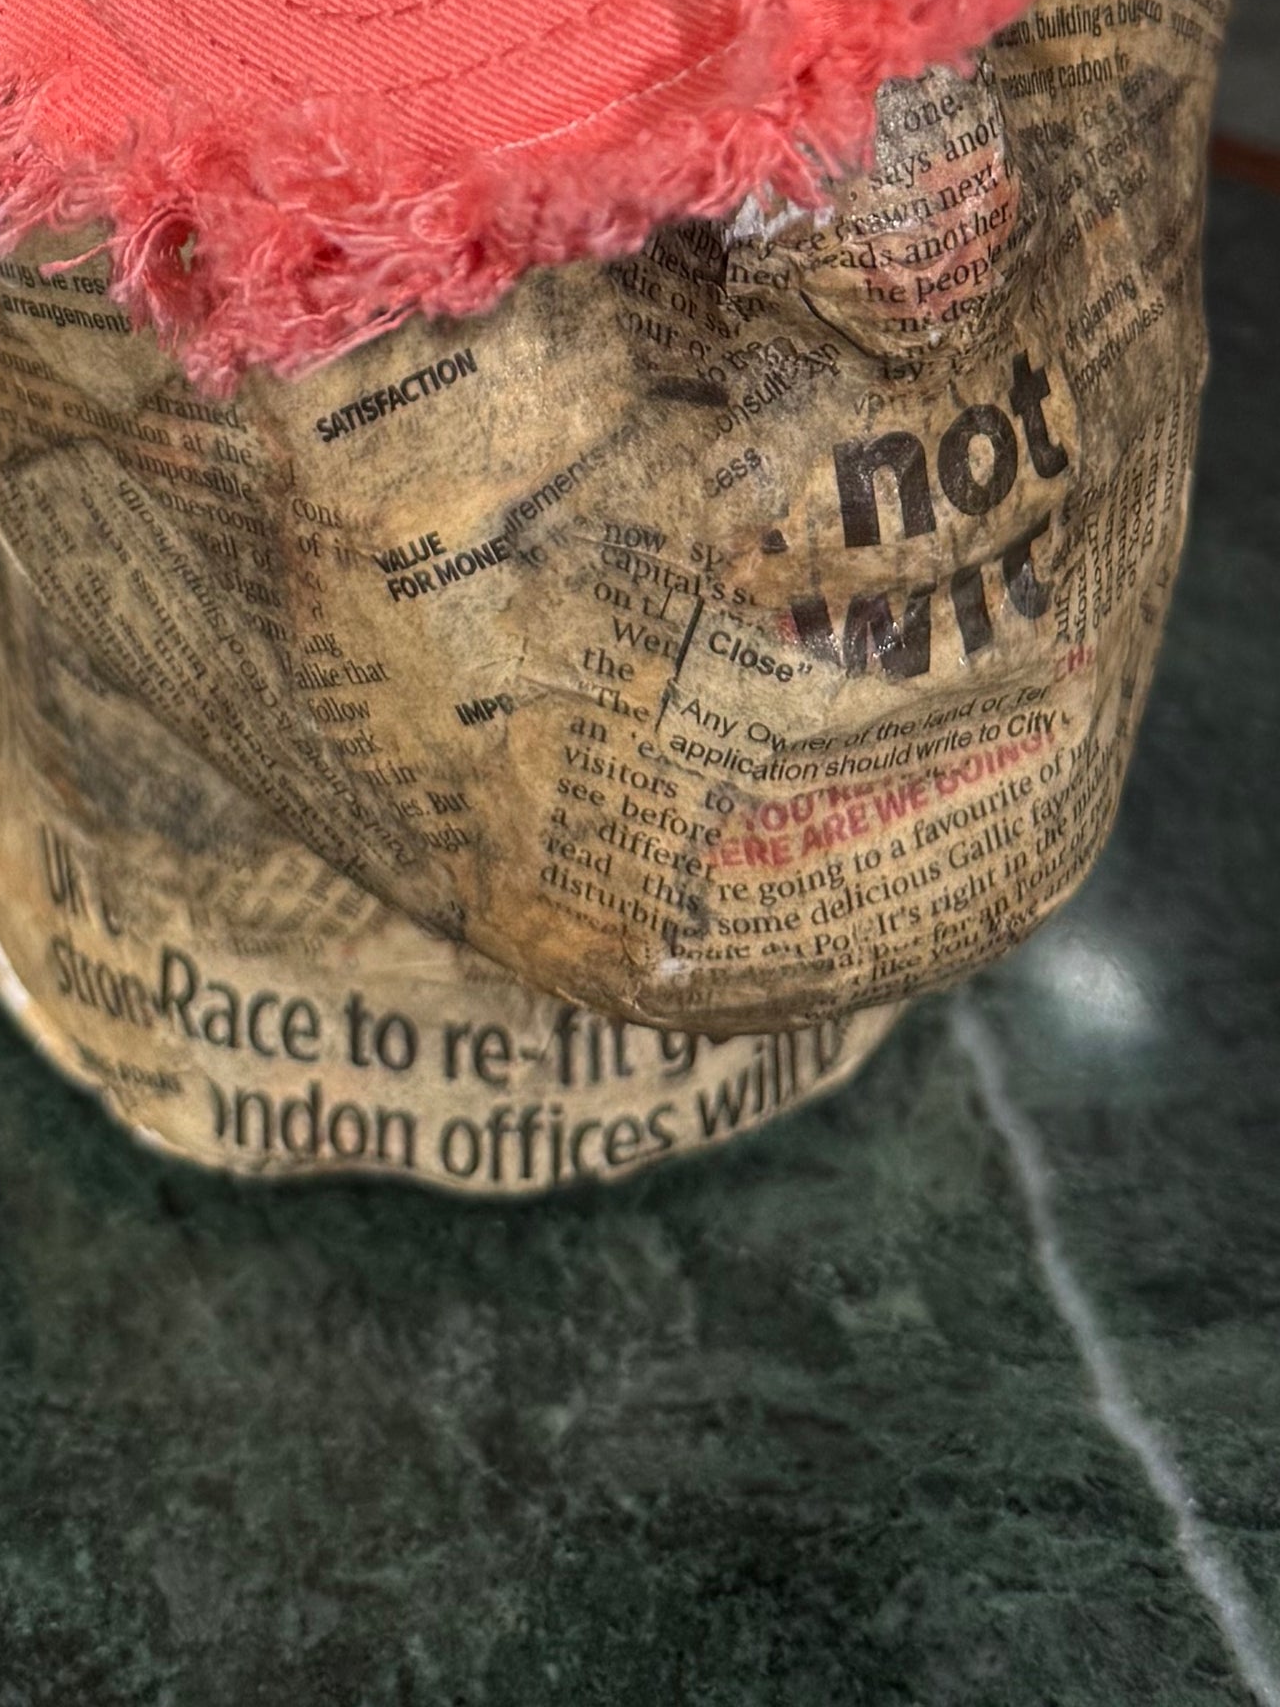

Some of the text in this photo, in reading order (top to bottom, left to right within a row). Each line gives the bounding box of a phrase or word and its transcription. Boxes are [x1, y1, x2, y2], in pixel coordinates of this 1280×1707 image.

[1033, 4, 1102, 40] building
[1057, 54, 1114, 88] carbon
[902, 93, 964, 134] one.
[937, 164, 999, 210] next
[904, 201, 1014, 265] another.
[314, 347, 479, 444] SATISFACTION
[832, 349, 1070, 549] not
[374, 531, 448, 575] VALUE
[604, 518, 670, 554] now
[386, 571, 439, 603] FOR
[593, 580, 632, 611] on
[344, 658, 391, 687] that
[582, 645, 635, 683] the
[569, 715, 609, 743] an
[669, 710, 1056, 785] application should write to City
[680, 697, 739, 739] Any
[747, 719, 837, 754] Owner
[875, 716, 917, 742] the
[921, 697, 977, 731] land
[980, 692, 1013, 715] or
[564, 745, 736, 814] visitors to
[550, 807, 567, 828] a
[557, 777, 722, 846] see before
[800, 806, 871, 858] ARE
[758, 860, 848, 907] going
[852, 848, 883, 871] to
[890, 838, 908, 860] a
[911, 775, 1035, 852] favourite
[545, 837, 614, 877] read
[642, 873, 702, 915] this
[718, 909, 801, 937] some
[810, 857, 942, 926] delicious
[946, 815, 1025, 871] Gallic
[876, 903, 922, 937] It's
[929, 866, 997, 918] right
[1003, 849, 1028, 878] in
[159, 944, 322, 1063] Race
[344, 989, 419, 1072] to
[438, 1101, 678, 1184] offices
